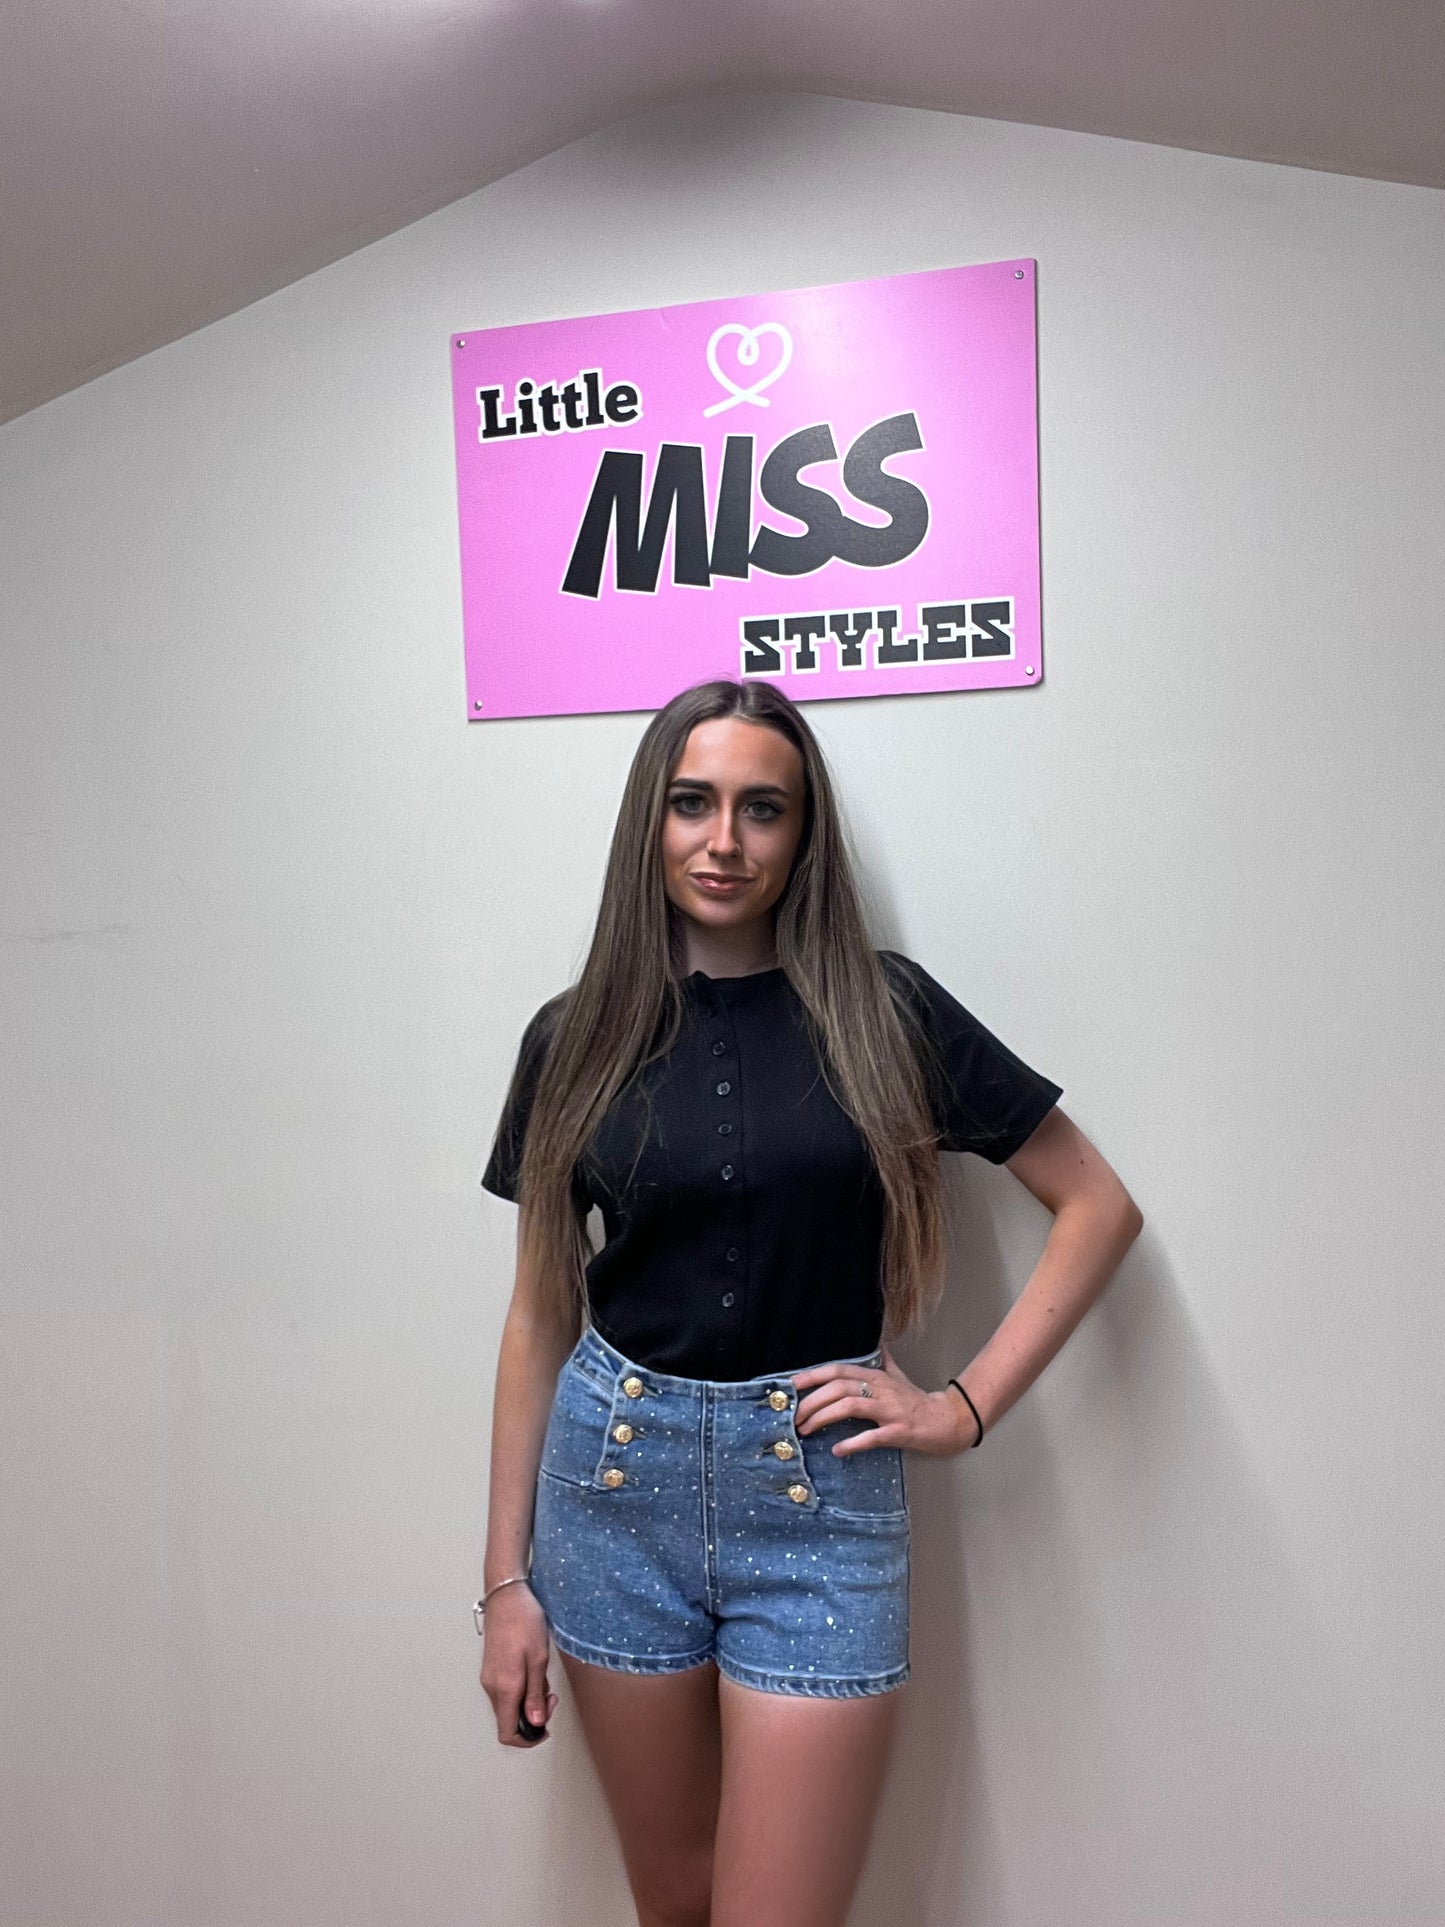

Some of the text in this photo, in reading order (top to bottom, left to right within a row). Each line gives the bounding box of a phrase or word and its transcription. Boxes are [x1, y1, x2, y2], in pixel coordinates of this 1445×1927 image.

[478, 370, 639, 440] Little
[560, 411, 931, 600] MISS
[742, 599, 1013, 674] STYLES
